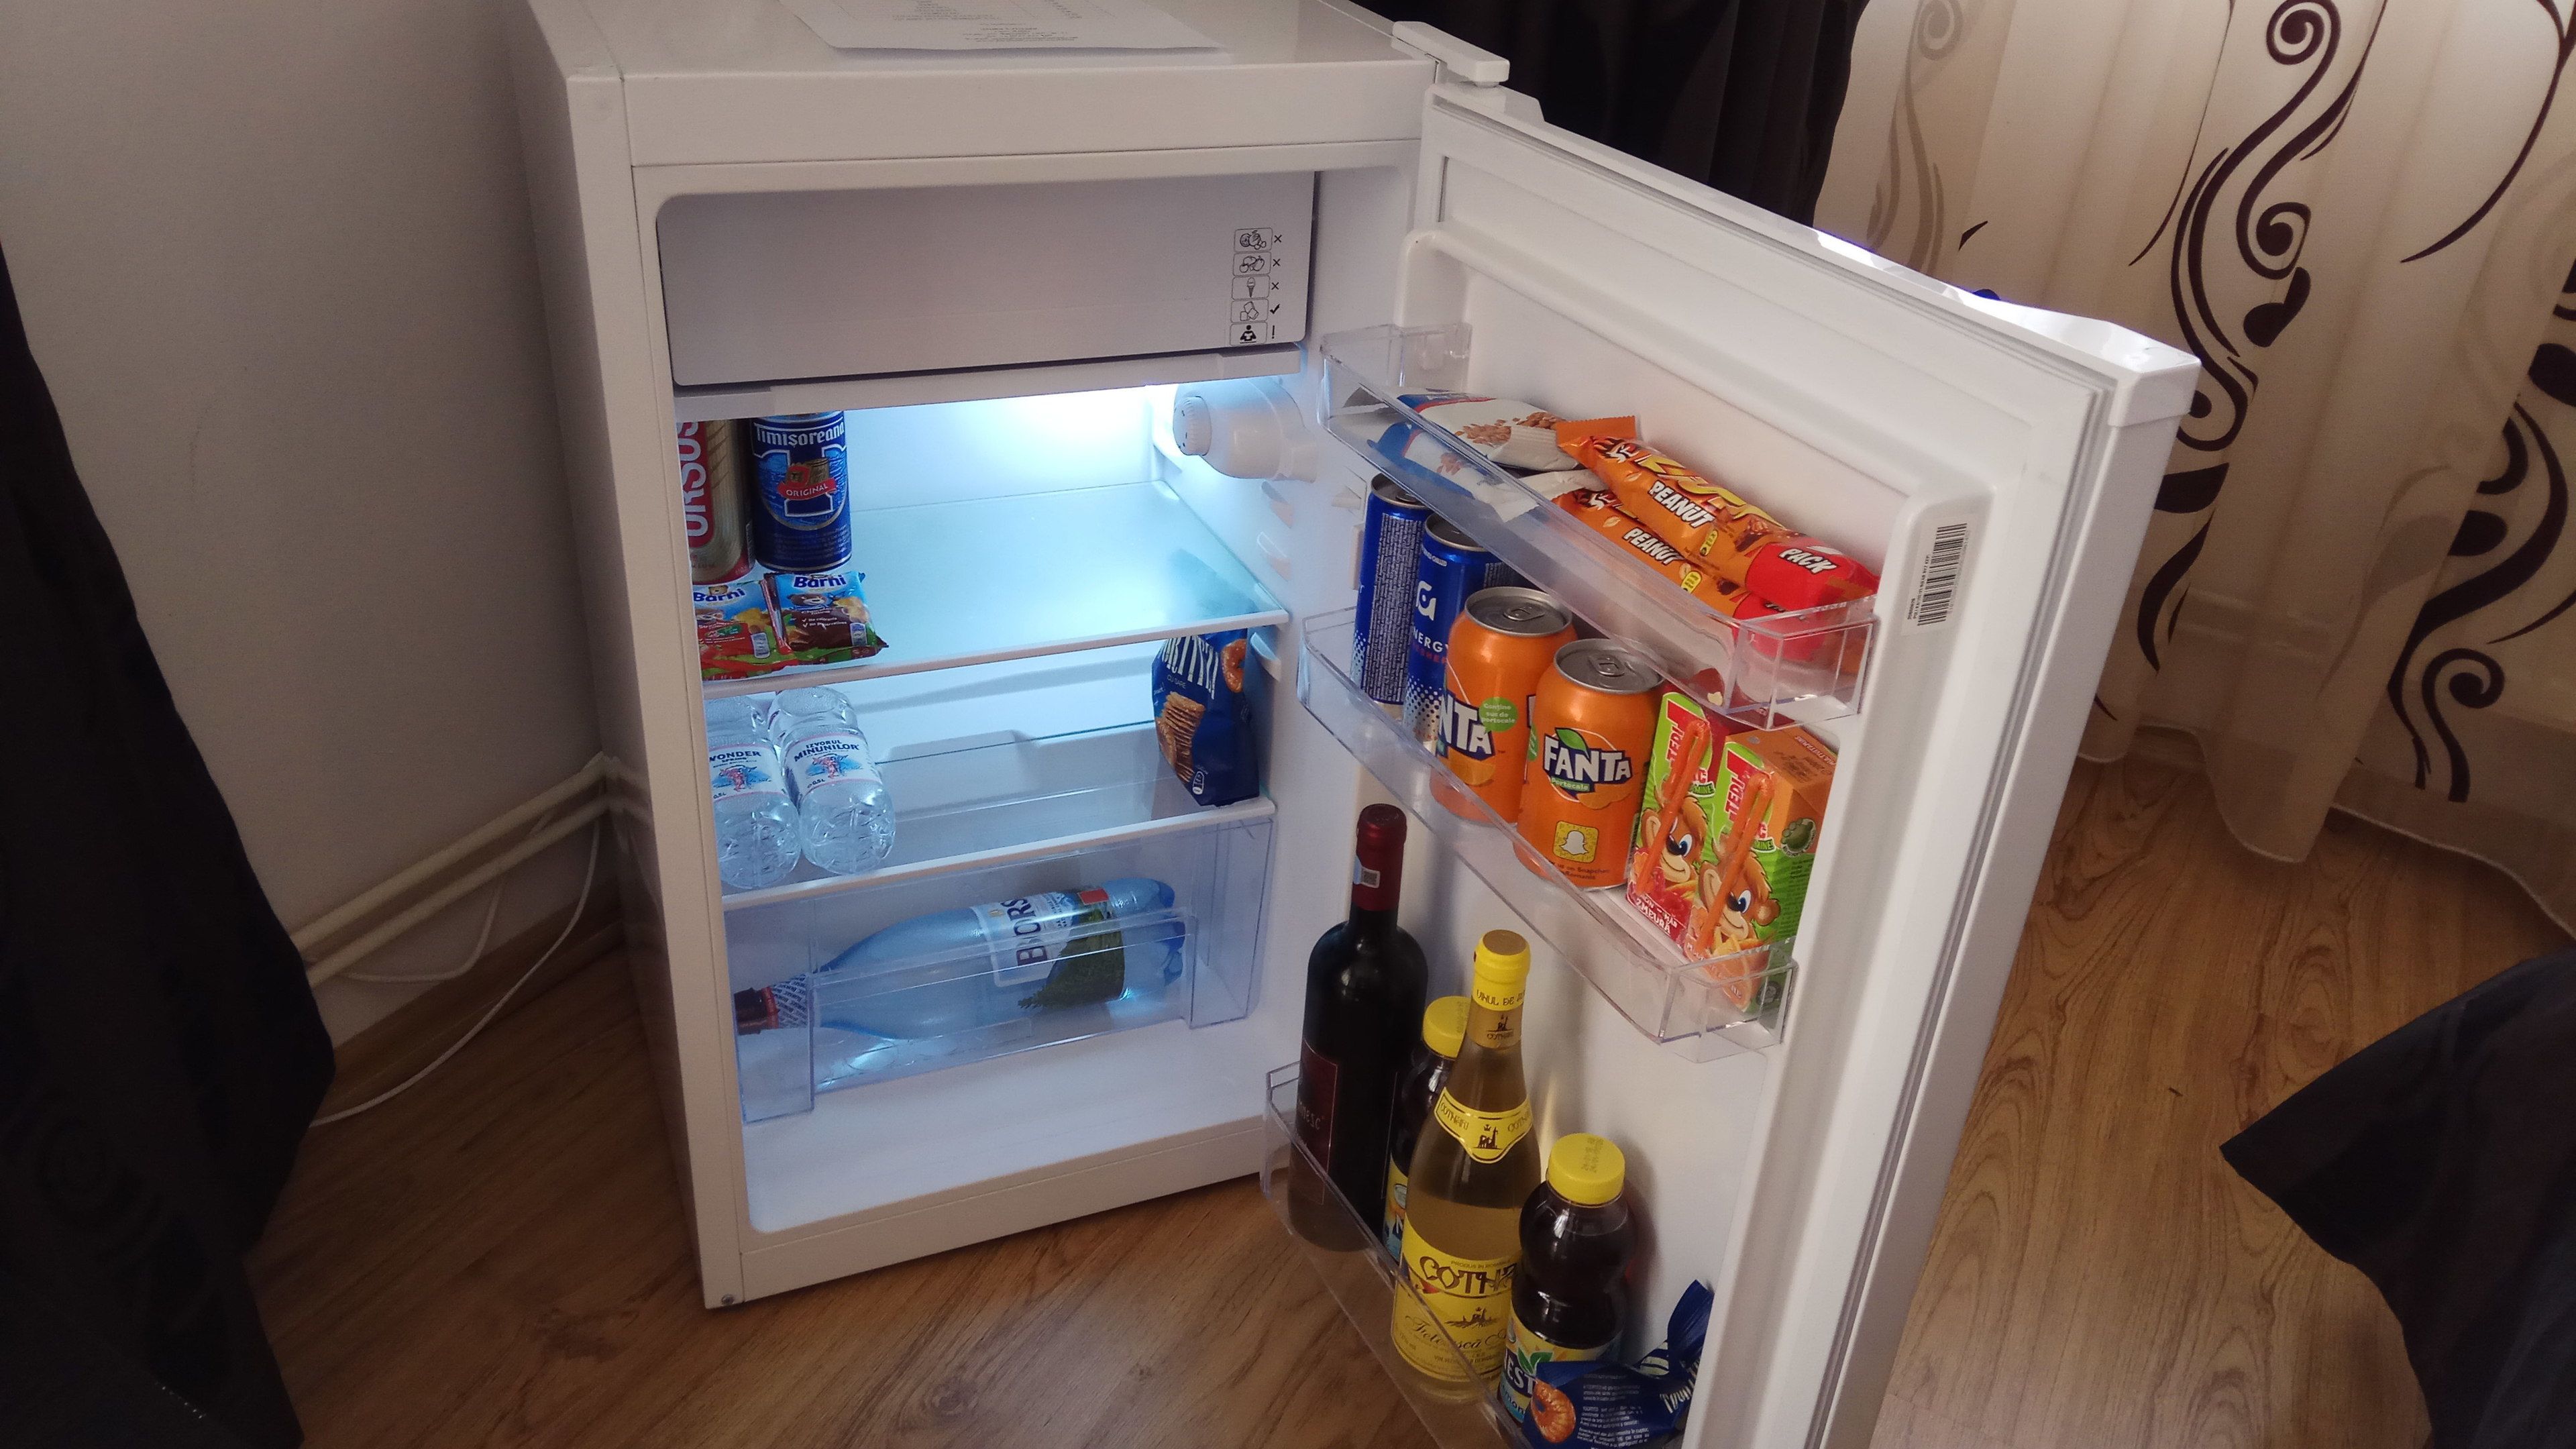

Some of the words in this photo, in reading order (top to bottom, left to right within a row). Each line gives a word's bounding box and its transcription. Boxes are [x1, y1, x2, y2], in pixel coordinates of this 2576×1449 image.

[786, 483, 828, 496] ORIGINAL
[1648, 480, 1717, 529] PEANUT
[1621, 527, 1686, 566] PEANUT
[1778, 547, 1840, 576] PACK
[794, 575, 847, 588] Barni
[693, 588, 746, 602] Barni
[1413, 626, 1448, 653] NERG
[806, 740, 843, 749] IZVORUL
[1544, 735, 1631, 782] FANTA
[1477, 989, 1499, 1006] VINUL
[1503, 996, 1515, 1006] DE
